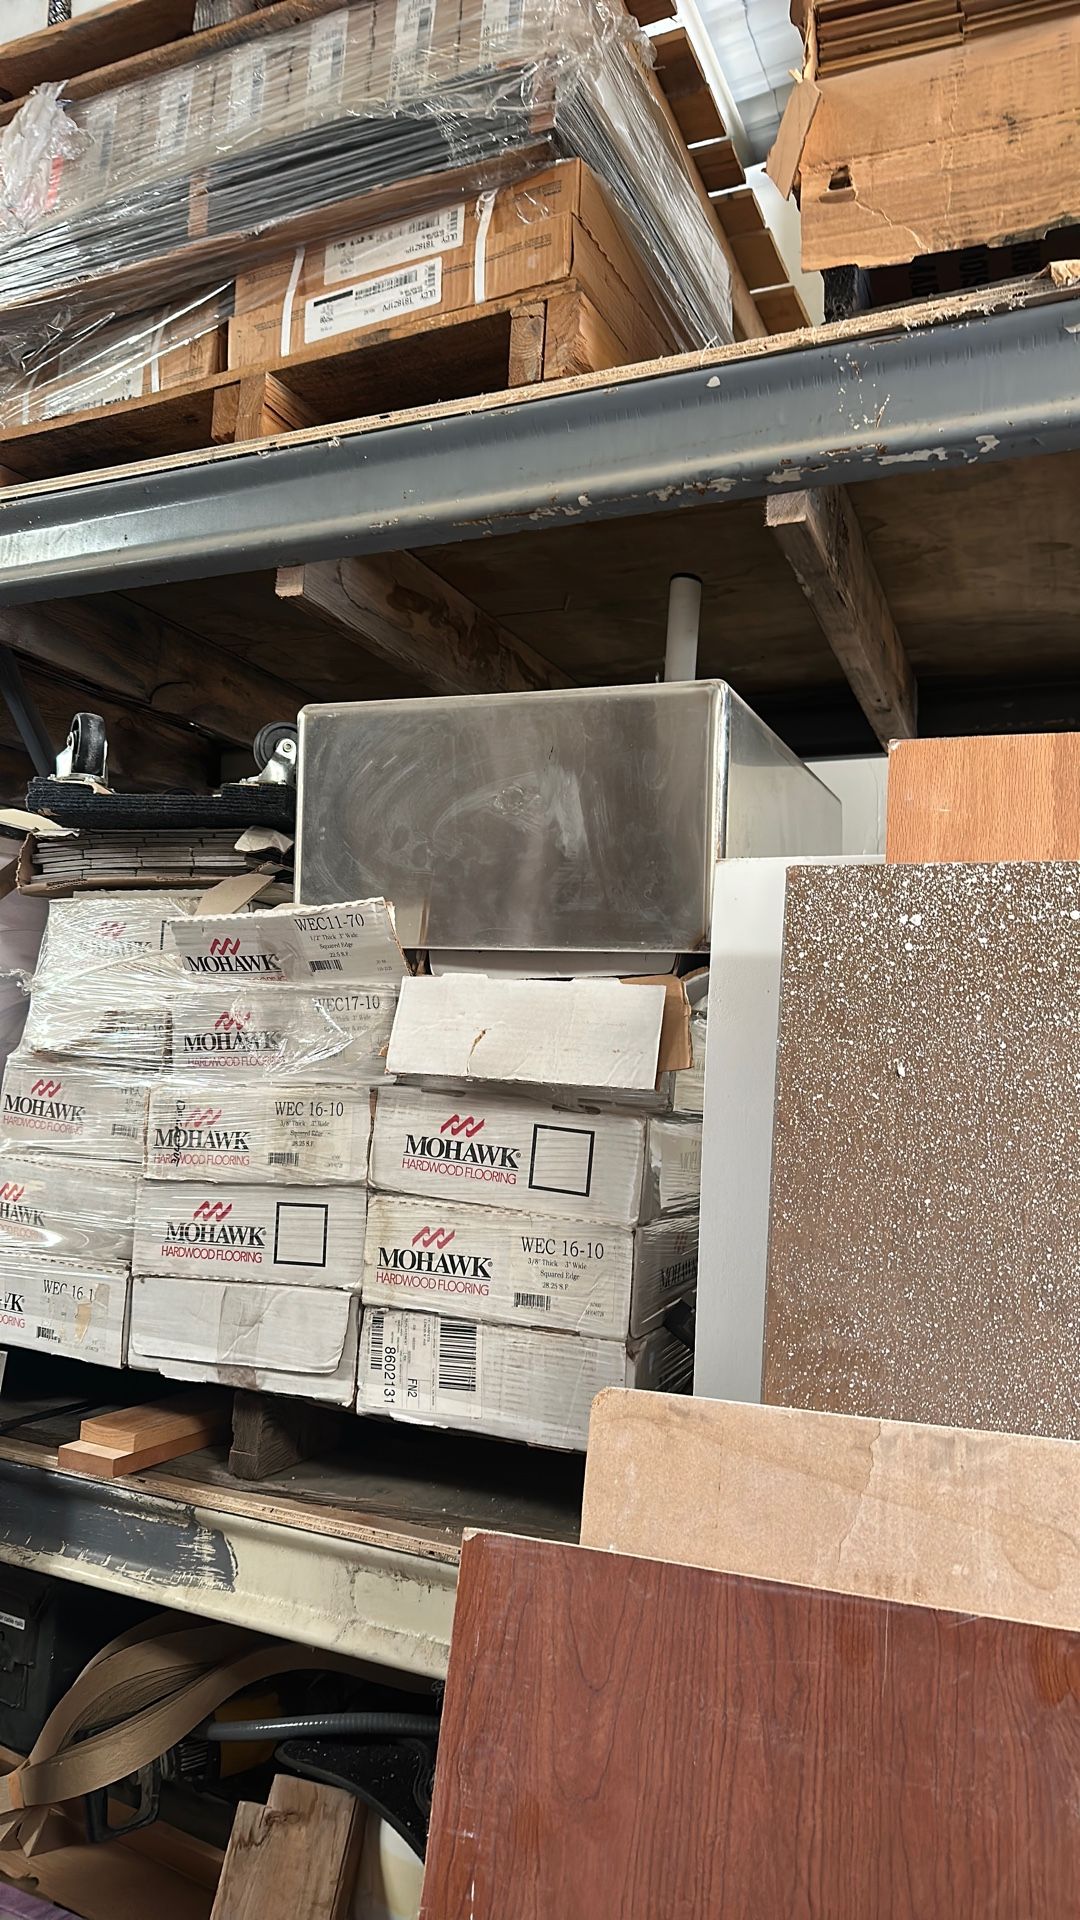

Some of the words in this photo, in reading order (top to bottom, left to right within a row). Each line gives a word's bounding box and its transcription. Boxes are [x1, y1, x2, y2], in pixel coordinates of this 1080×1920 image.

[294, 913, 364, 931] WEC11-70
[186, 954, 282, 972] MOHAWK
[3, 1094, 84, 1122] MOHAWK
[275, 1102, 304, 1116] WEC
[309, 1102, 343, 1116] 16-10
[153, 1128, 250, 1151] MOHAWK
[206, 1154, 250, 1166] FLOORING
[404, 1133, 519, 1170] MOHAWK
[401, 1157, 464, 1178] HARDWOOD
[464, 1167, 518, 1185] FLOORING
[165, 1221, 265, 1247] MOHAWK
[161, 1245, 215, 1262] HARDWOOD
[216, 1249, 262, 1264] FLOORING
[521, 1236, 556, 1255] WEC
[562, 1240, 604, 1259] 16-10
[376, 1247, 491, 1279] MOHAWK
[542, 1259, 558, 1267] Thick
[572, 1262, 587, 1270] Wide
[375, 1271, 437, 1290] HARDWOOD
[437, 1279, 490, 1297] FLOORING
[540, 1270, 564, 1279] Squared
[565, 1273, 580, 1281] Edge
[383, 1346, 396, 1404] 8602131
[407, 1377, 418, 1398] FN2
